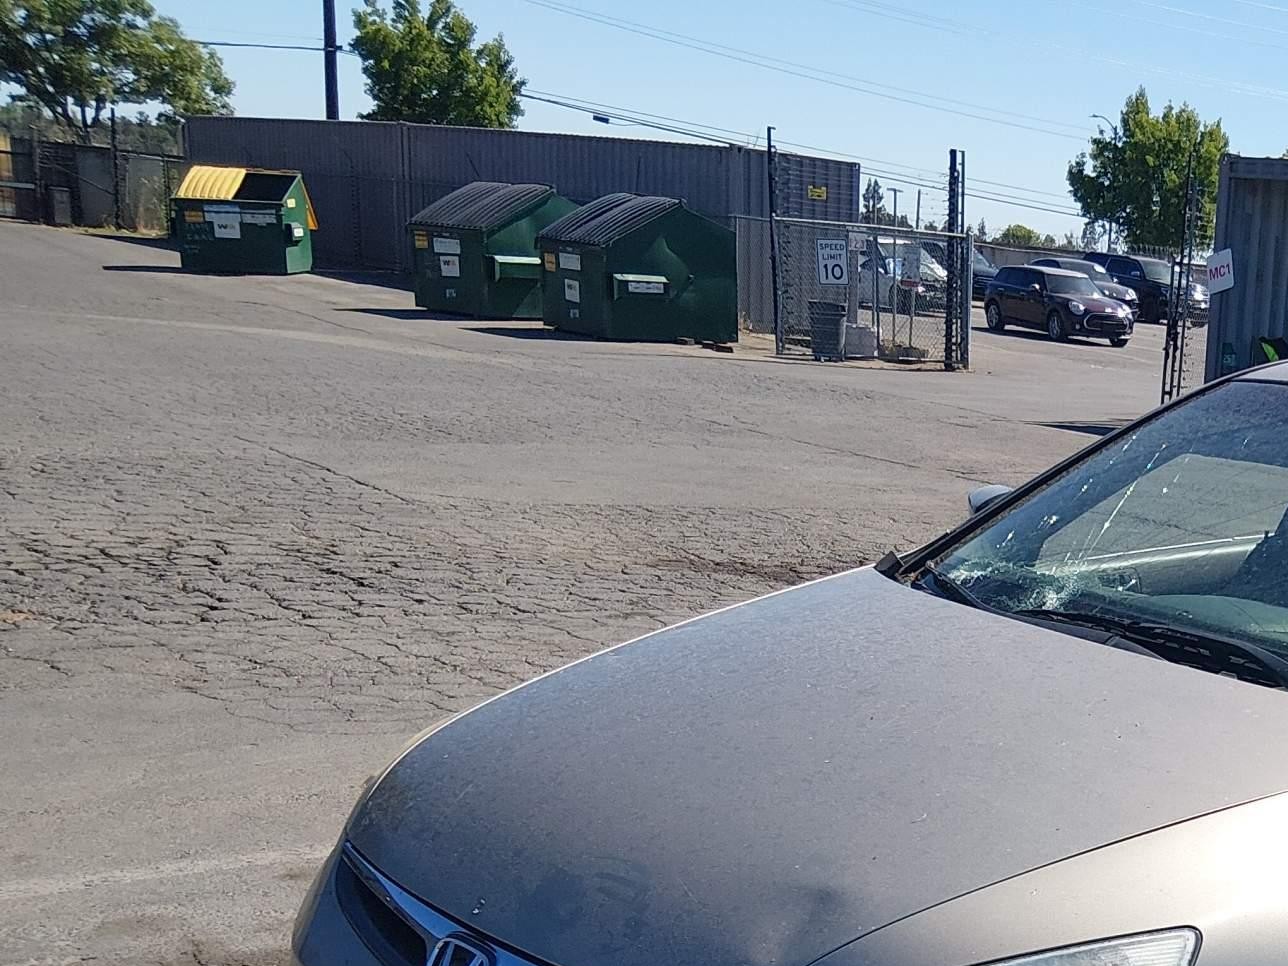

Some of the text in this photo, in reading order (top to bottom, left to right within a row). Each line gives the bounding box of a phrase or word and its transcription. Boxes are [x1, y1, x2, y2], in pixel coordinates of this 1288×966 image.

[819, 242, 845, 251] SPEED
[823, 263, 844, 280] 10
[1208, 263, 1231, 281] MC1
